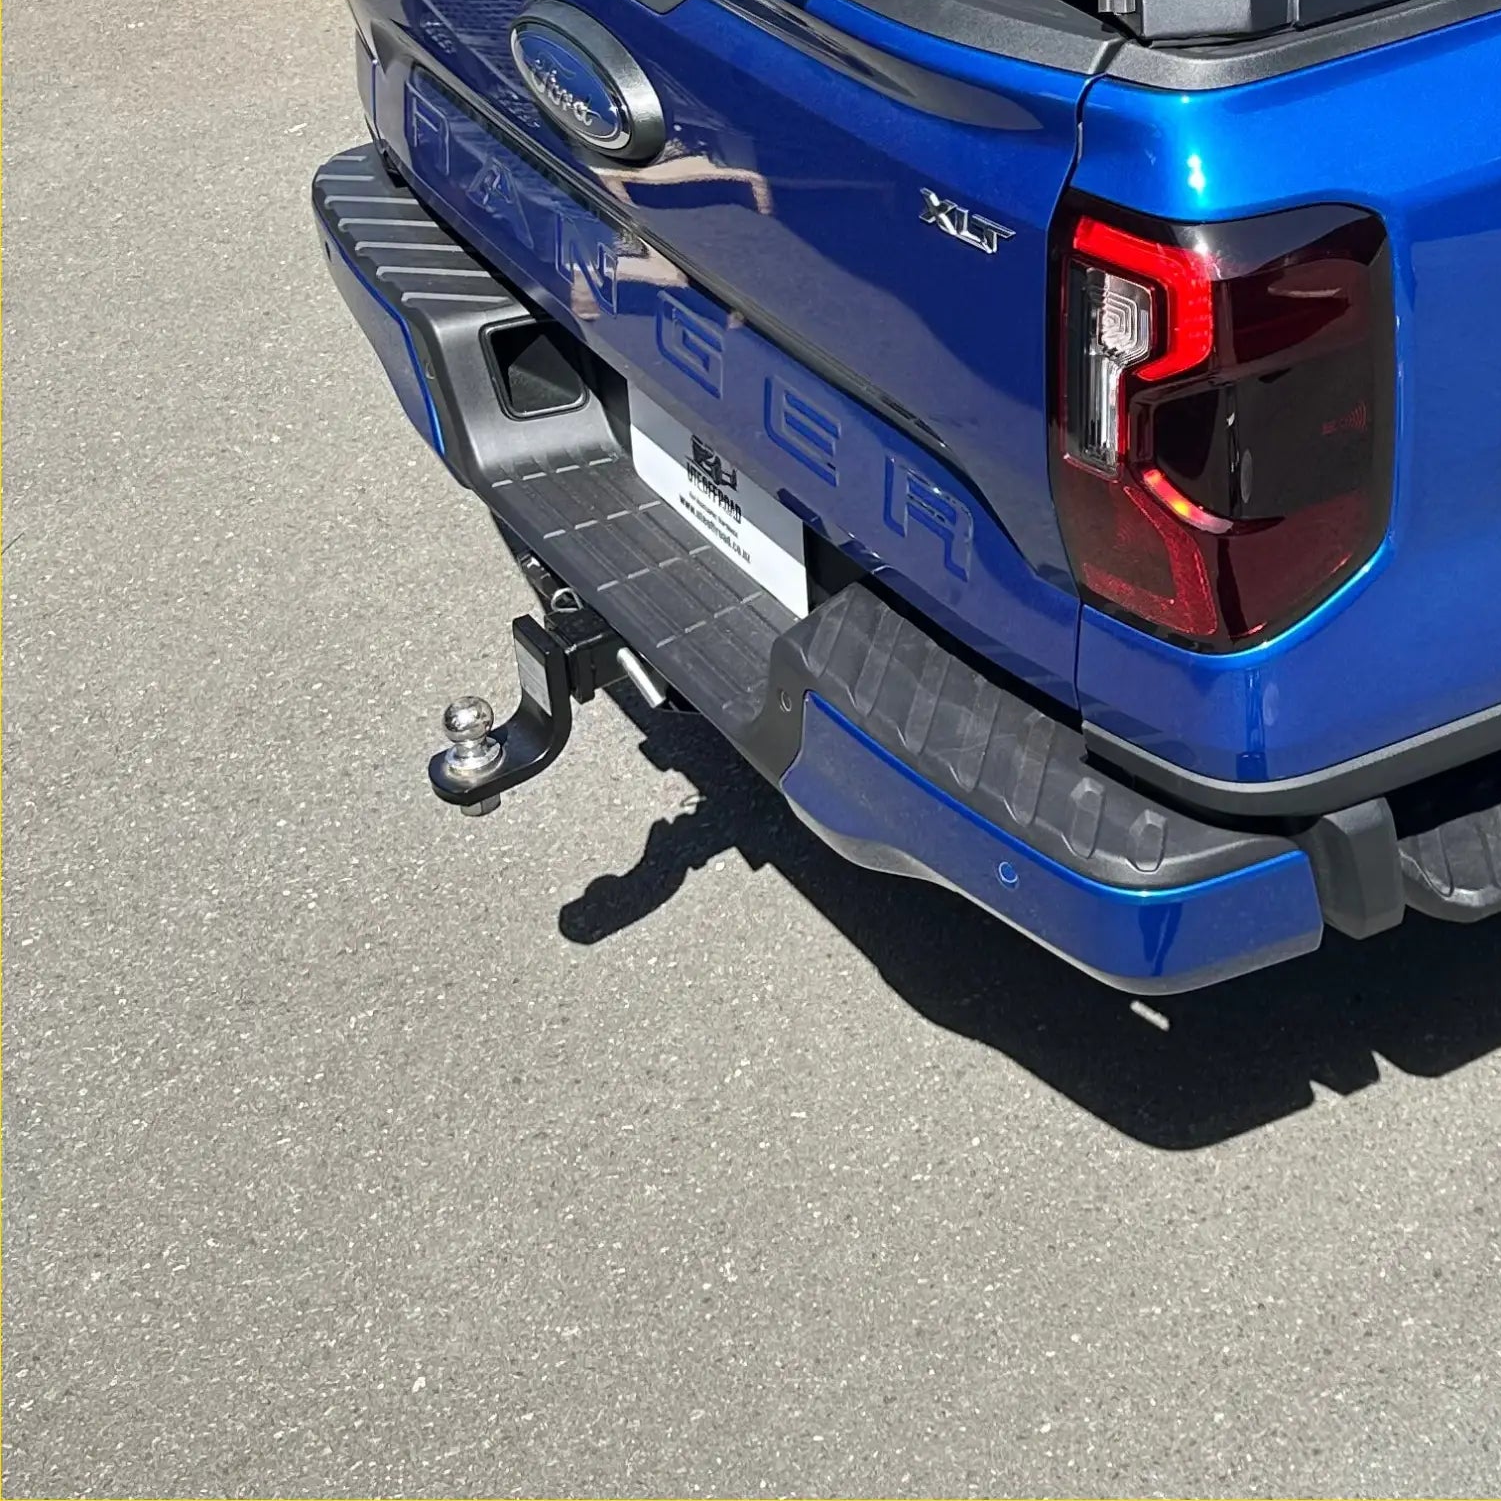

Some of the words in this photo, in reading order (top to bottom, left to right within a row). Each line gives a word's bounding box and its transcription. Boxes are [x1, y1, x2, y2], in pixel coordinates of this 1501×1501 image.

[528, 52, 596, 127] Ford
[919, 187, 1017, 254] XLT
[404, 75, 973, 582] RANGER
